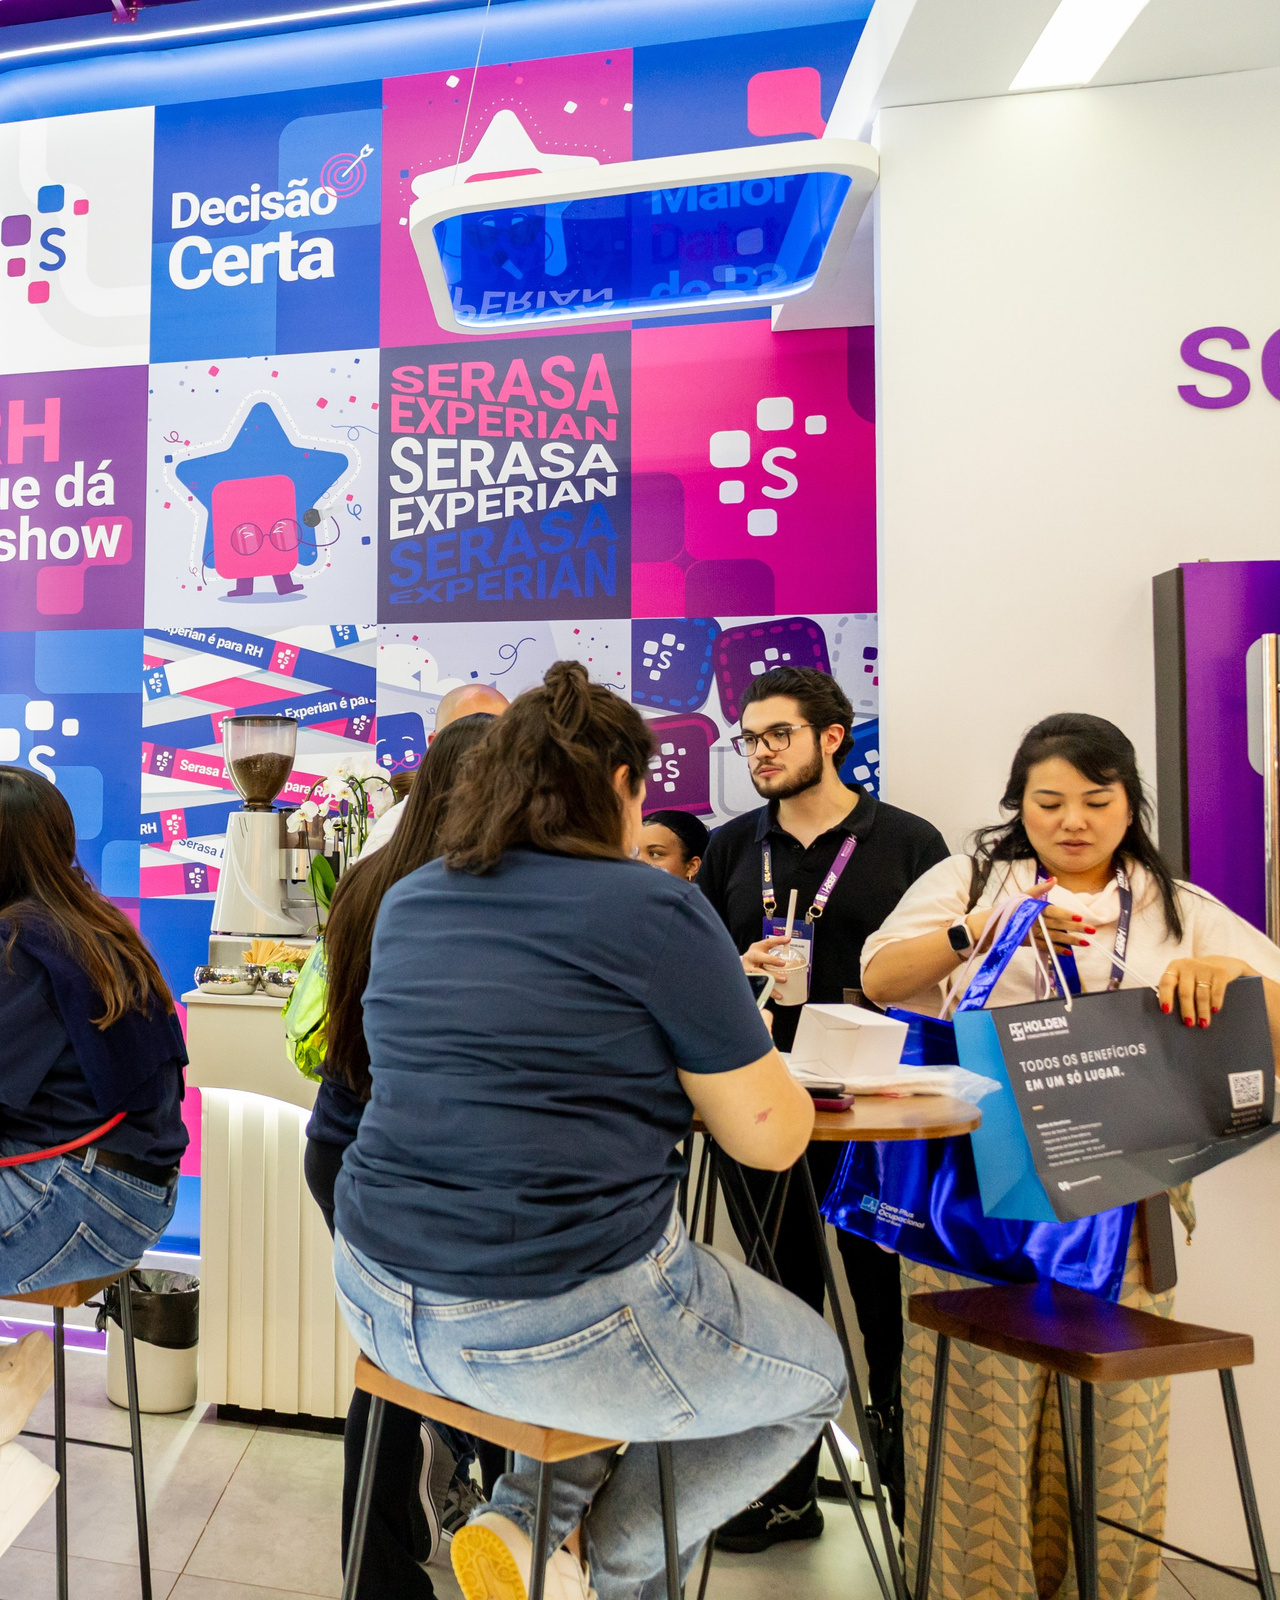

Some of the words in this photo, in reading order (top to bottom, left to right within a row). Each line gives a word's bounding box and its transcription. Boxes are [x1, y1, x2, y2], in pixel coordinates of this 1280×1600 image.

[171, 177, 338, 229] Decisão
[168, 230, 336, 290] Certa
[390, 353, 620, 415] SERASA
[390, 393, 618, 442] EXPERIAN
[389, 436, 620, 495] SERASA
[54, 459, 116, 508] dá
[389, 475, 618, 541] EXPERIAN
[389, 502, 619, 588] SERASA
[389, 544, 618, 605] EXPERIAN
[158, 627, 207, 643] xperian
[207, 633, 217, 645] é
[216, 638, 243, 653] para
[244, 643, 264, 658] RH
[284, 701, 338, 720] Experian
[339, 696, 348, 709] é
[179, 759, 220, 778] Serasa
[284, 781, 311, 795] para
[140, 822, 158, 836] RH
[178, 839, 218, 857] Serasa
[1023, 1016, 1068, 1033] HOLDEN
[1019, 1056, 1060, 1073] TODOS
[1062, 1053, 1079, 1067] OS
[1080, 1043, 1147, 1064] BENEFÍCIOS
[1025, 1078, 1044, 1092] EM
[1045, 1075, 1065, 1089] UM
[1066, 1069, 1082, 1085] SÓ
[1084, 1065, 1125, 1082] LUGAR.
[877, 1208, 926, 1229] Ocupacional
[880, 1202, 899, 1213] Care
[899, 1208, 915, 1219] Plus
